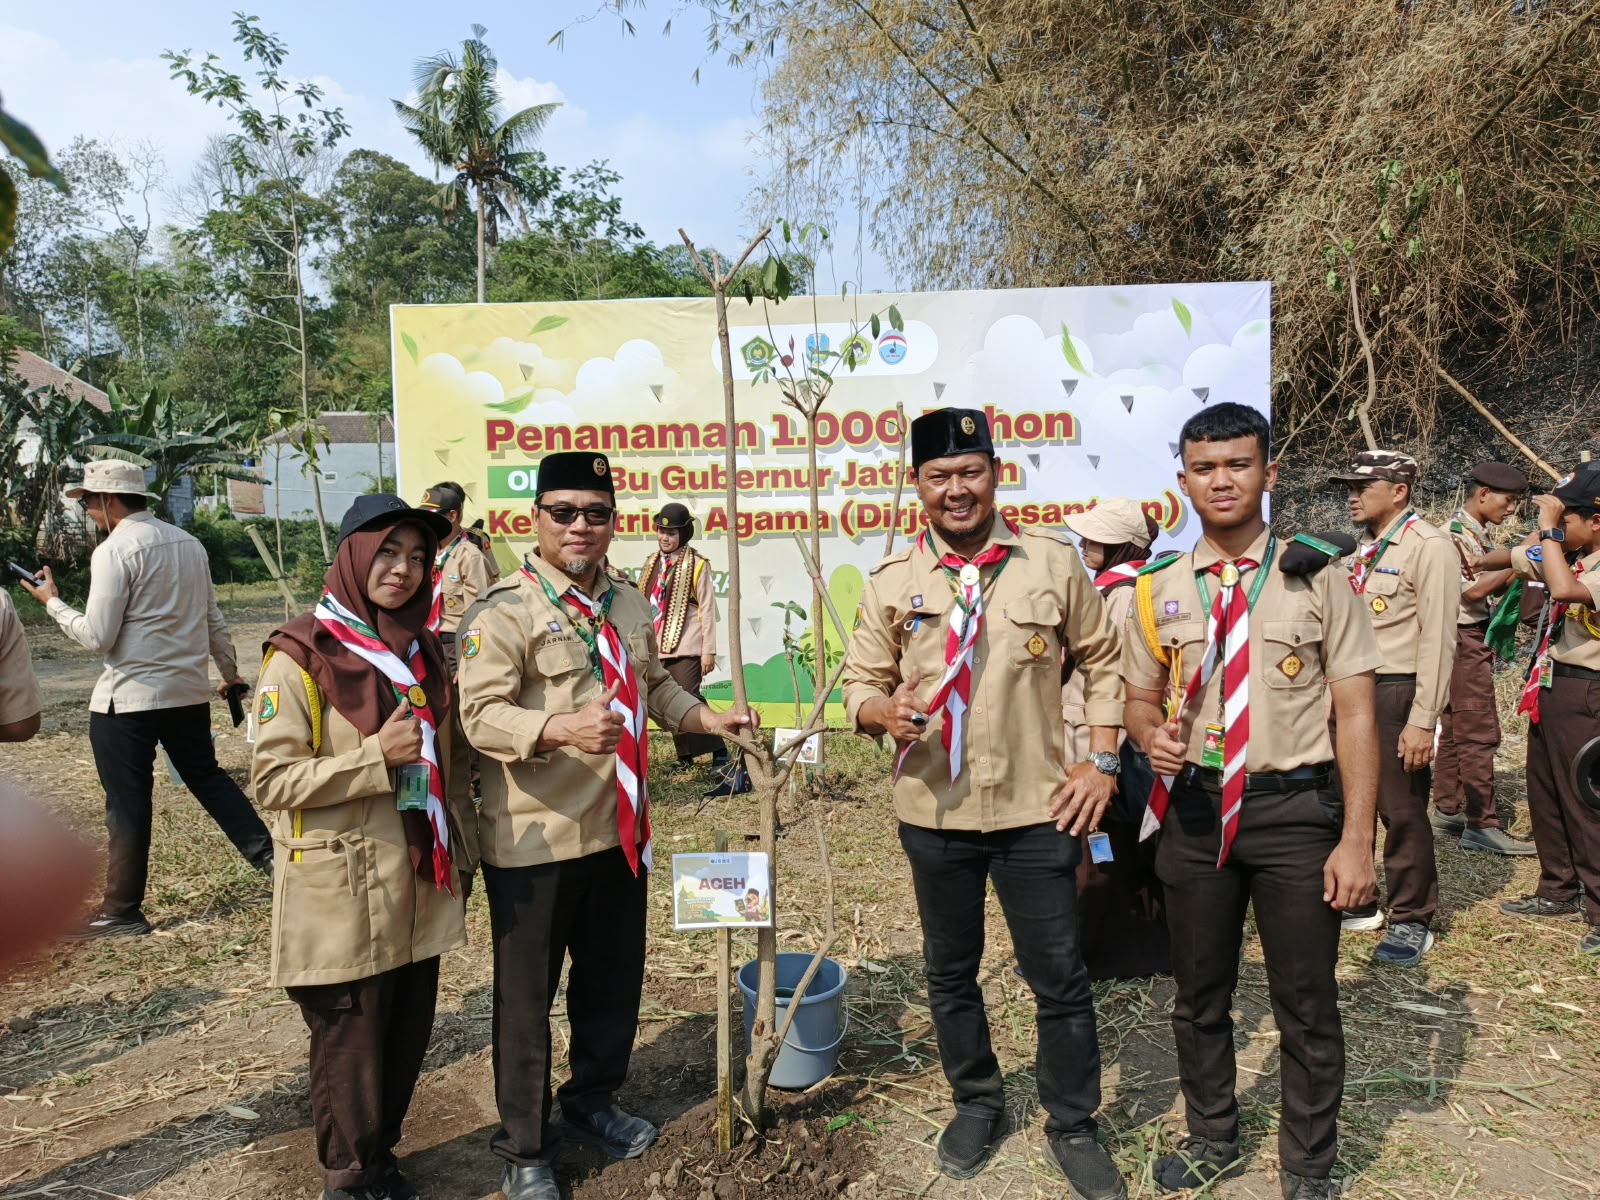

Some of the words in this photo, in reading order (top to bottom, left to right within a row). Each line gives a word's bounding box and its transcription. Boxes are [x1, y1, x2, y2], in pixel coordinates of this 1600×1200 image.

[486, 419, 757, 452] Penanaman
[772, 410, 907, 446] 1.000
[923, 405, 1072, 440] hon
[507, 469, 538, 491] Ol
[661, 463, 831, 491] Gubernur
[841, 461, 917, 487] Jati
[704, 506, 829, 538] Agama
[699, 877, 745, 890] ACEH
